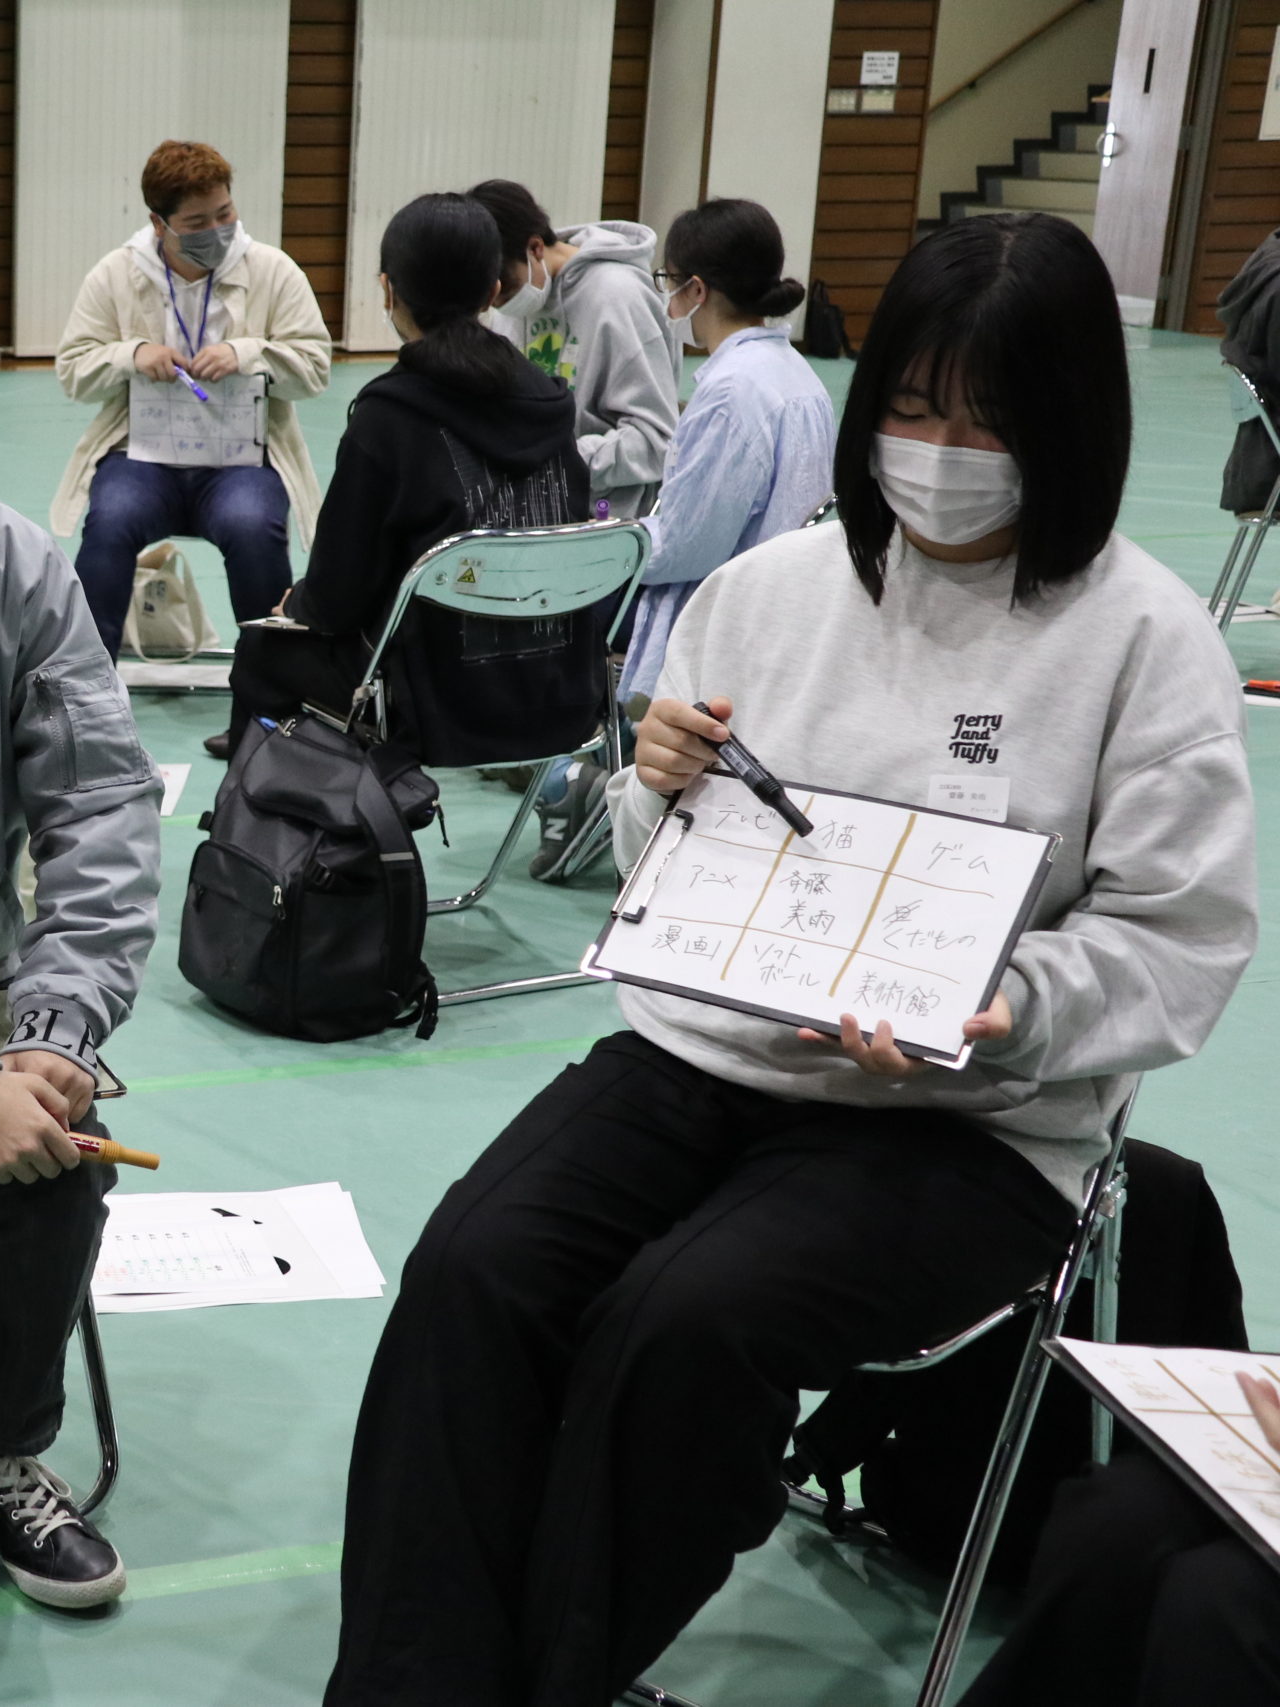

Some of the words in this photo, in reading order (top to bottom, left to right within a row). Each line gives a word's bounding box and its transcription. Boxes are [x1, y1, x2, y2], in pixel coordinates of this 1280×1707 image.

[950, 714, 1003, 739] Jerry
[960, 728, 991, 740] and
[949, 742, 999, 764] Tuffy
[818, 819, 857, 849] 猫
[927, 842, 990, 874] ゲーム
[689, 865, 738, 888] アニメ
[652, 925, 722, 960] 漫画
[883, 928, 977, 950] くだもの
[760, 964, 820, 986] ボール
[853, 971, 941, 1016] 美術館
